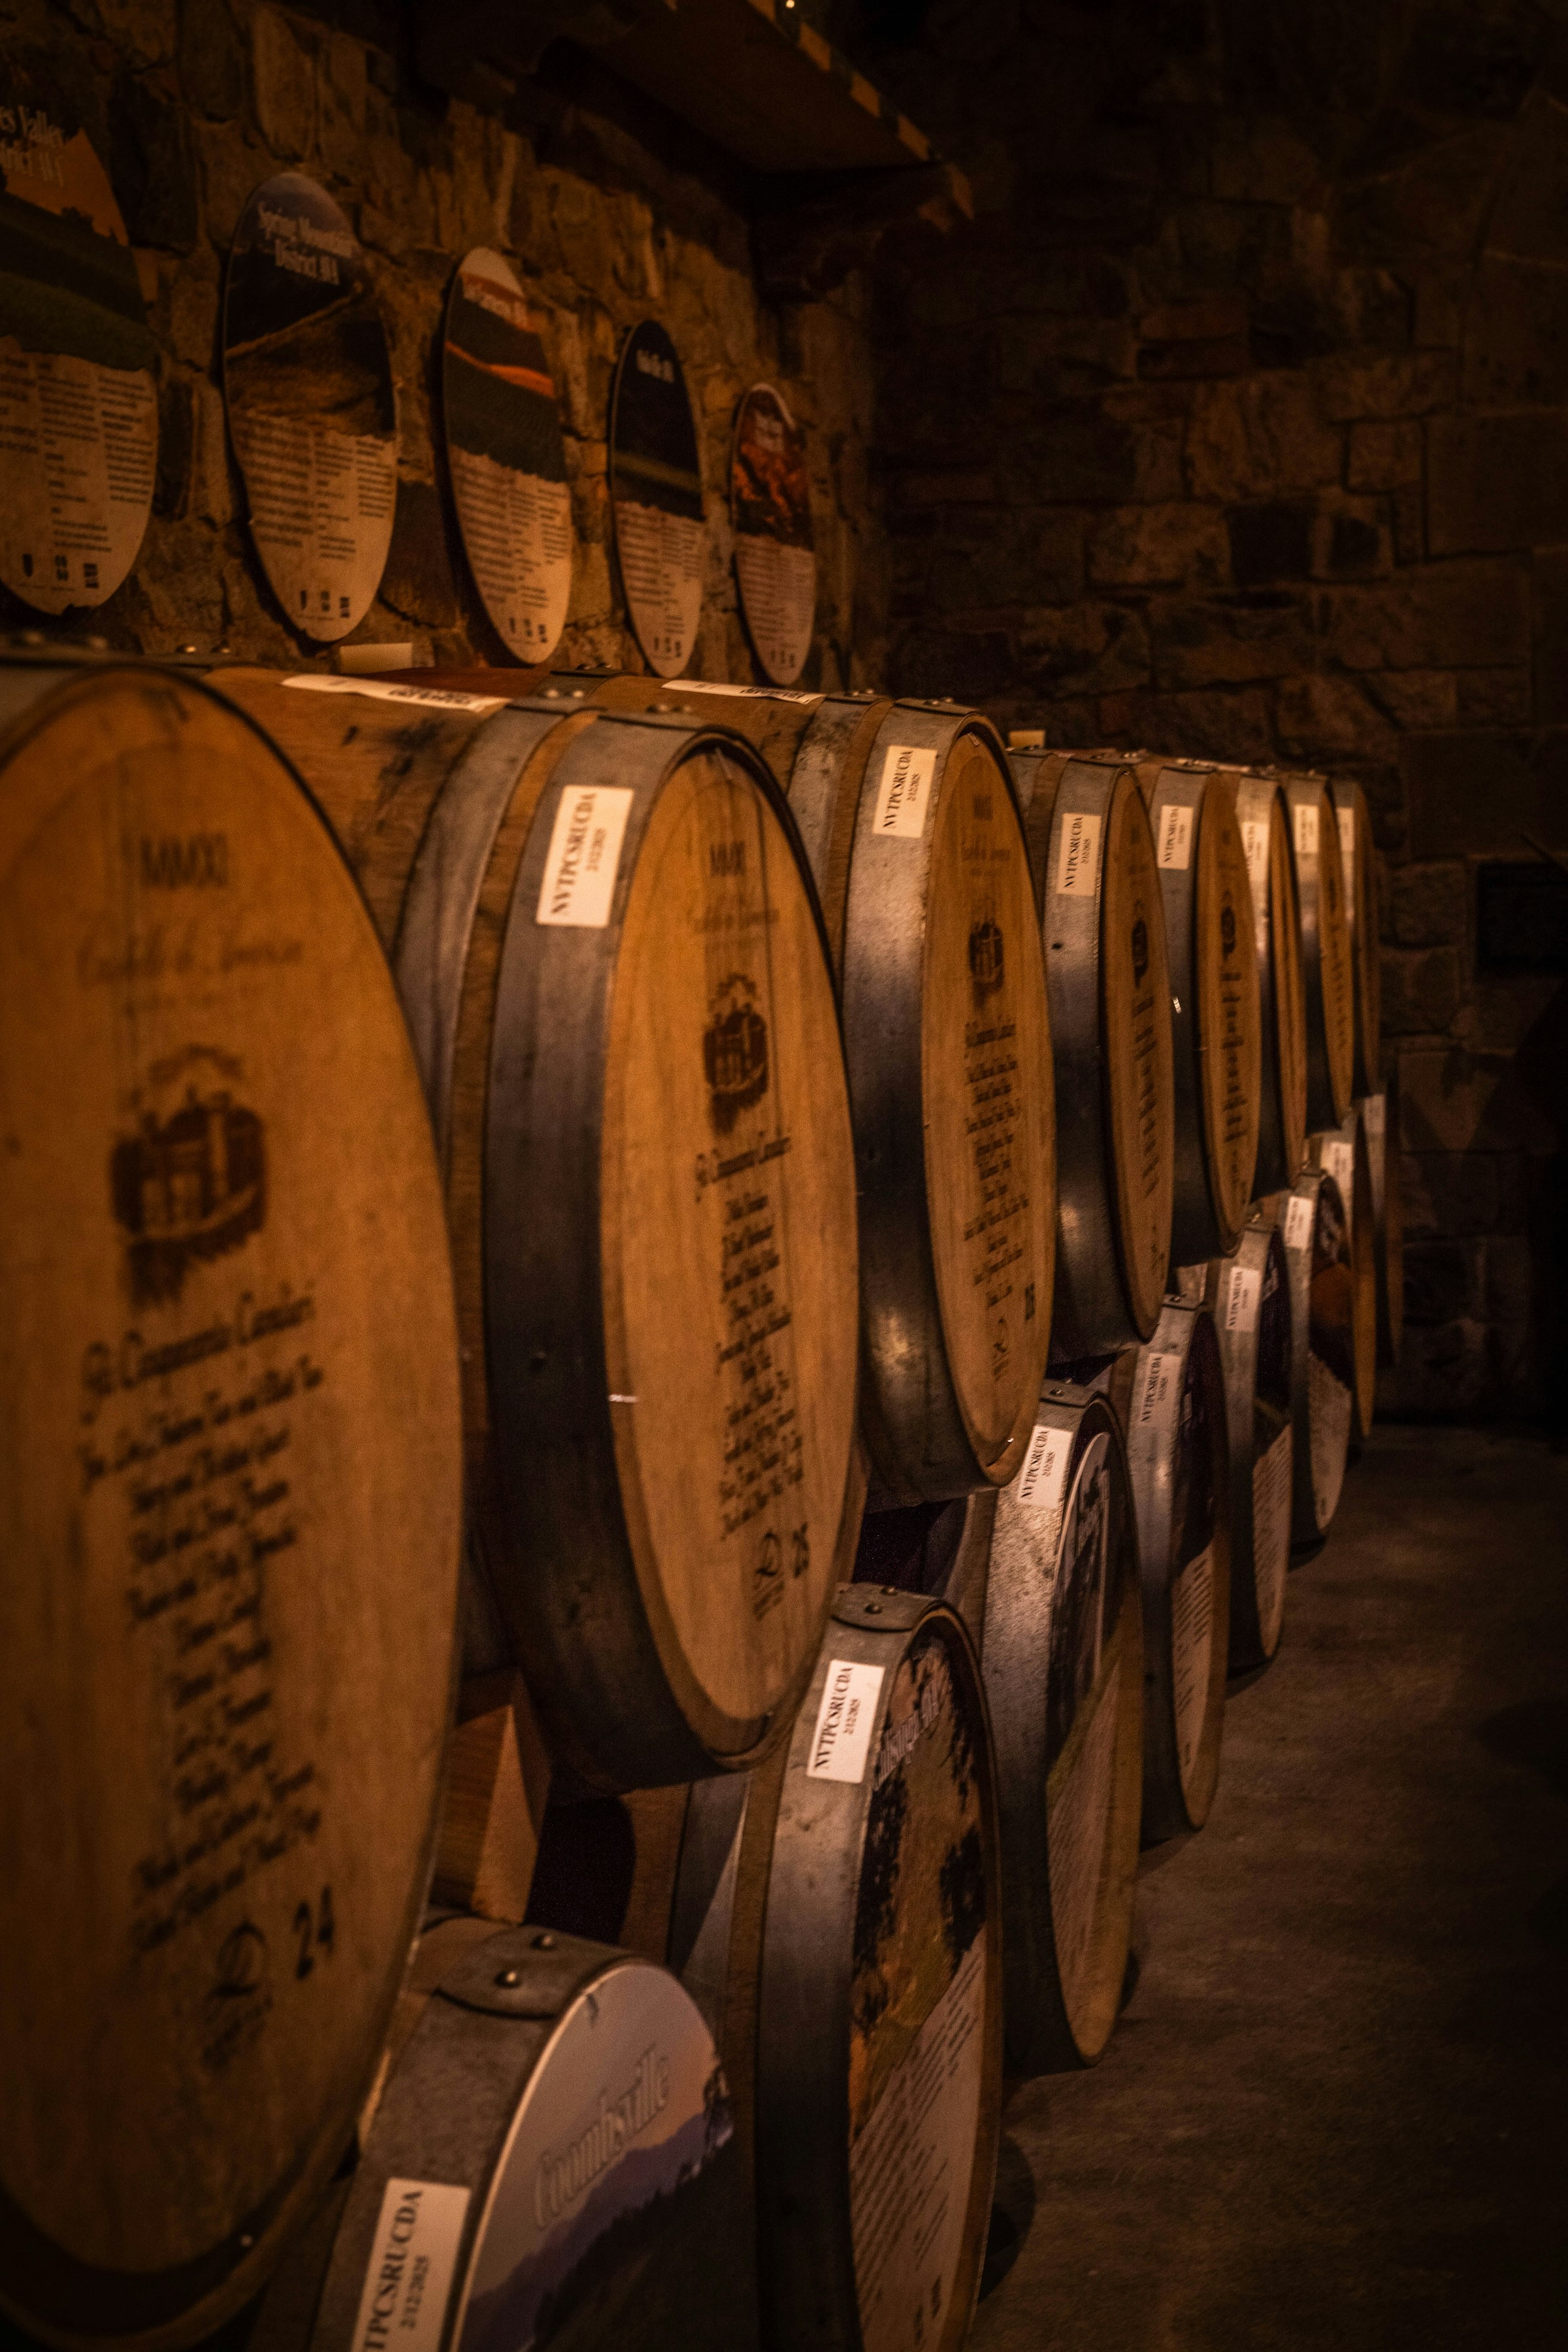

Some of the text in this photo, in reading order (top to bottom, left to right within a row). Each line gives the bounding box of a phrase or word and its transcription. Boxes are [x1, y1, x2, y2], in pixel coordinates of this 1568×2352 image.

[883, 751, 913, 828] NVTPCSRUCDA
[551, 792, 596, 915] NVTPCSRUCDA
[1064, 817, 1083, 888] NVTPCSRUCDA
[1021, 1431, 1048, 1498] NVTPCSRUCDA
[814, 1667, 853, 1769] NVTPCSRUCDA
[293, 1884, 335, 1981] 24
[399, 2255, 429, 2330] 2/12/2025
